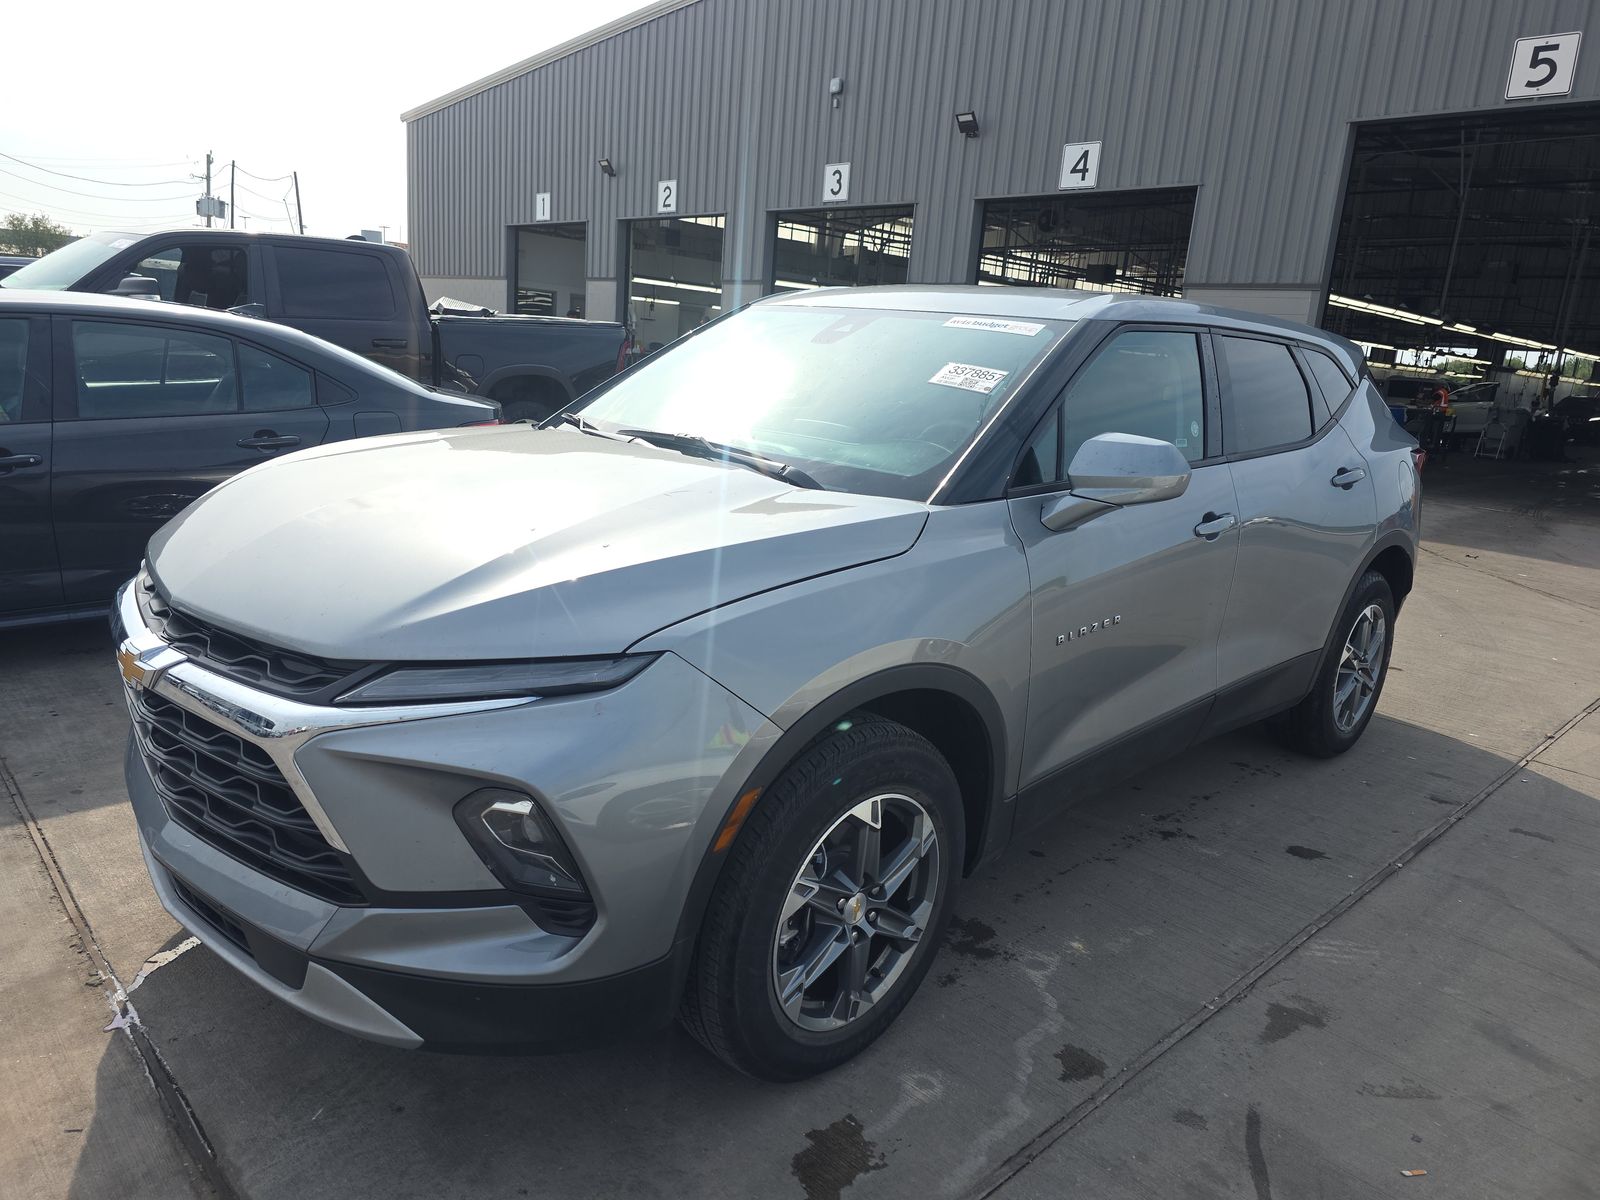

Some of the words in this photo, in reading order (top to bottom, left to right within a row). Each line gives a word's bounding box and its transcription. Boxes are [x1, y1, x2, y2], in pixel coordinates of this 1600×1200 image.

[1524, 43, 1560, 88] 5
[1069, 149, 1090, 182] 4
[830, 169, 843, 196] 3
[541, 197, 546, 217] 1
[662, 185, 672, 208] 2
[972, 320, 1009, 329] budget
[948, 365, 1006, 382] 3378857
[1056, 615, 1121, 646] BLAZER
